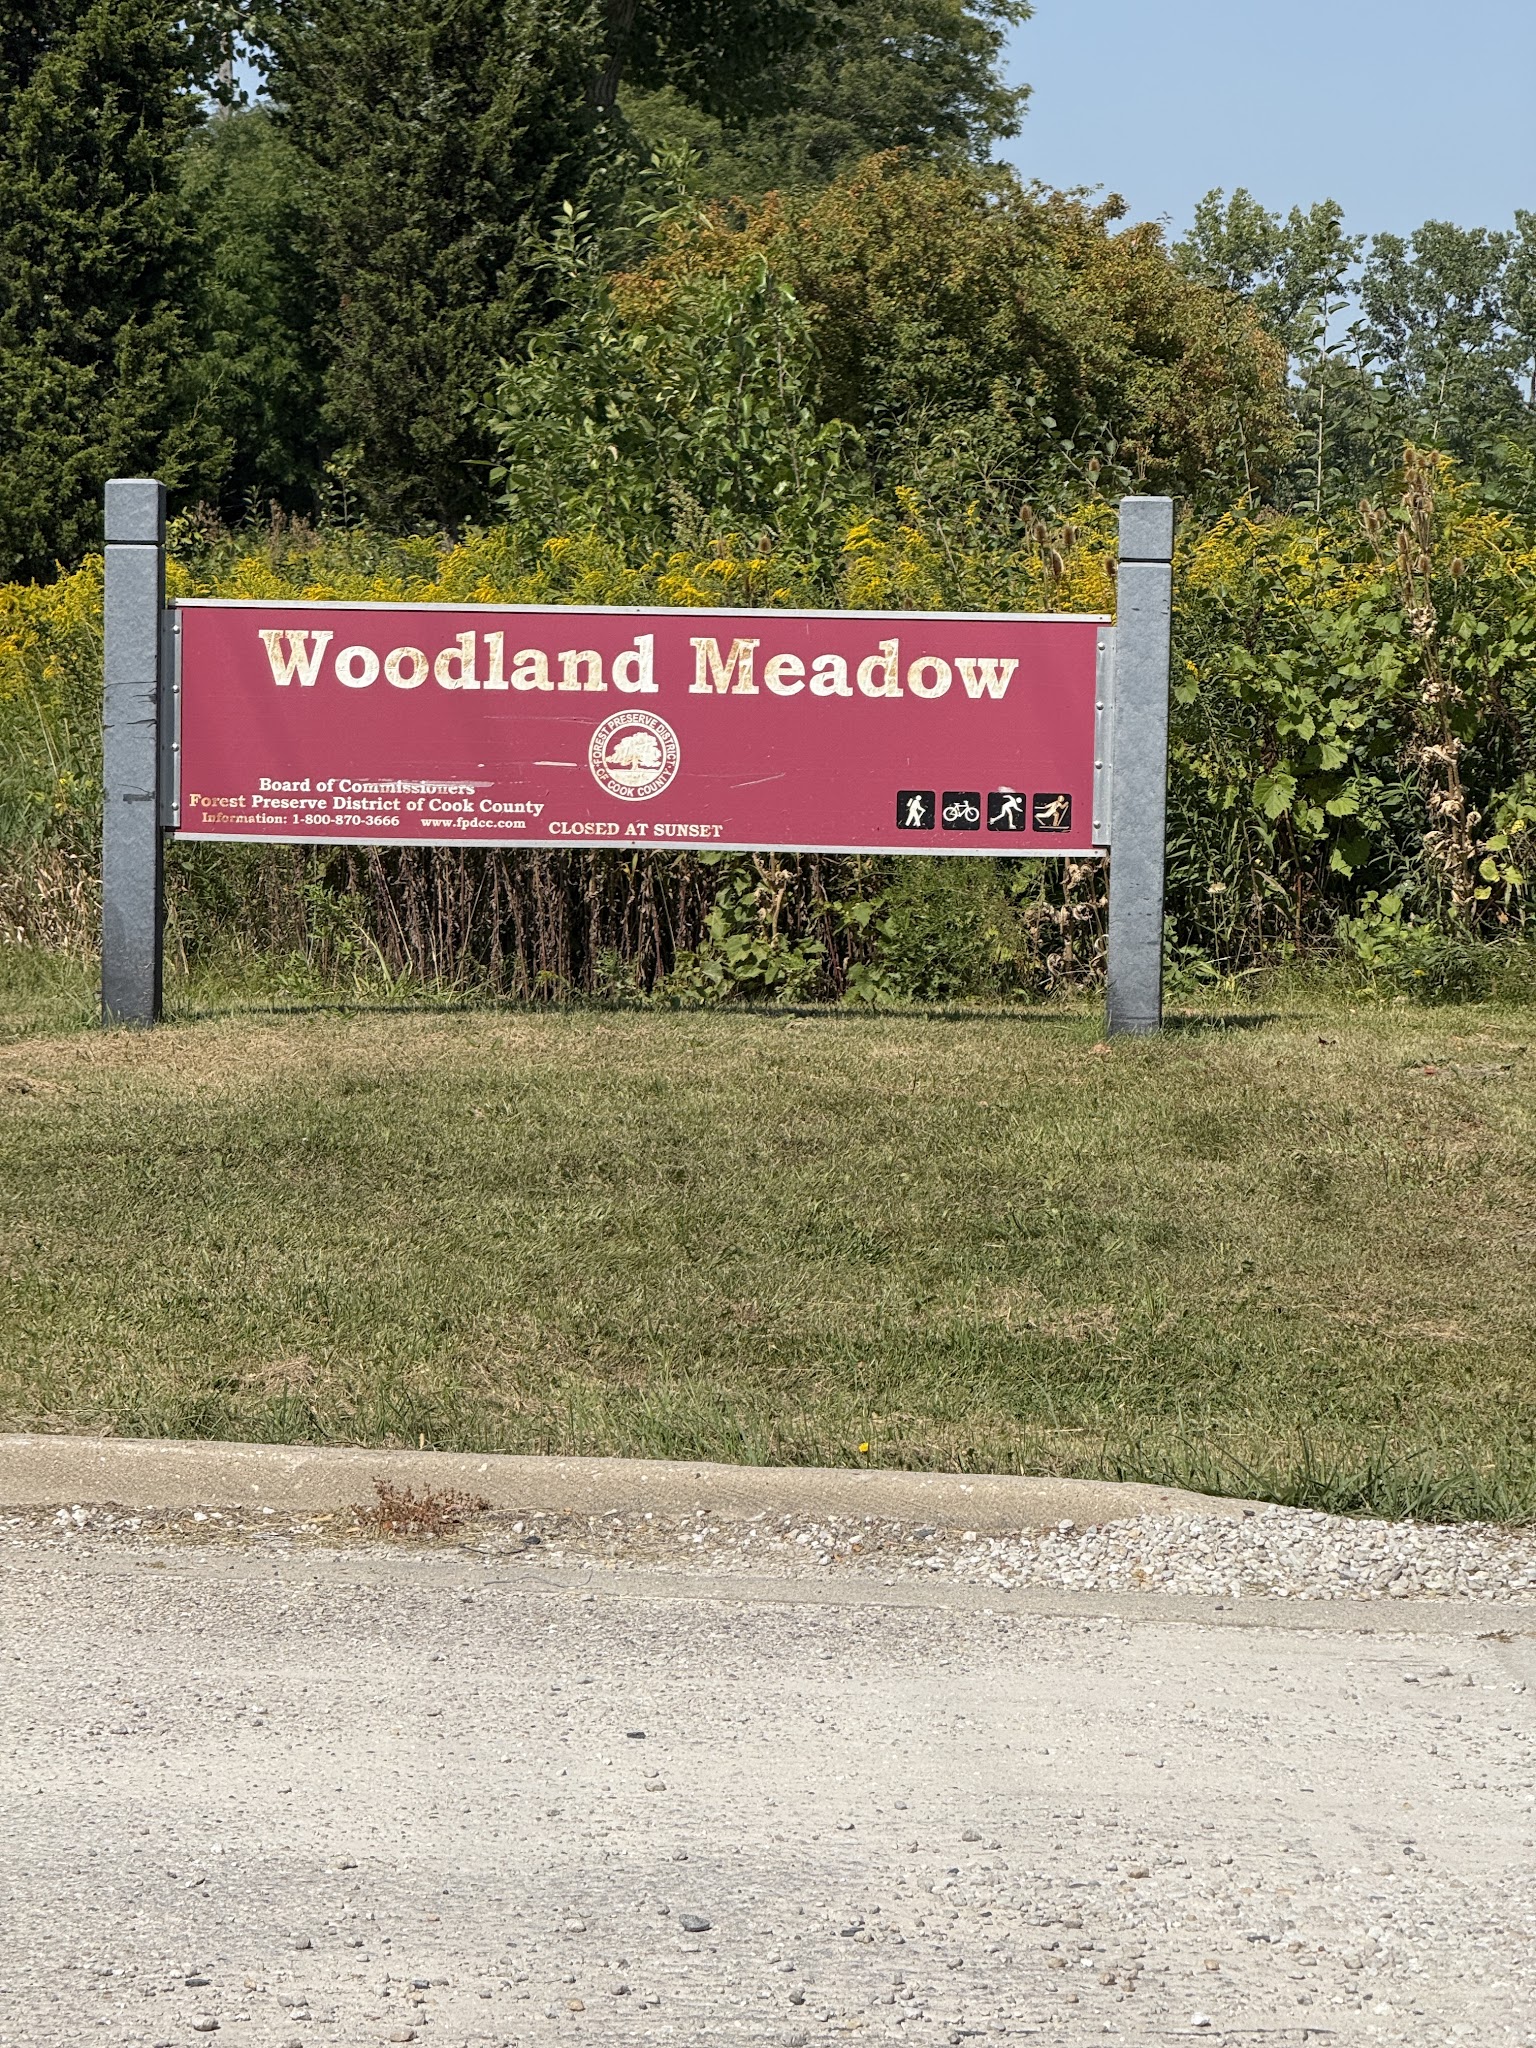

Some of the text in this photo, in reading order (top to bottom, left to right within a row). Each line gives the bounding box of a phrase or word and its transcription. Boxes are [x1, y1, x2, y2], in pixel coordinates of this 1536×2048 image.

[258, 629, 1019, 699] Woodland Meadow
[593, 713, 676, 766] FOREST PRESERVE DISTRICT
[259, 777, 475, 795] Board of Commissioners
[596, 768, 672, 797] OF COOK COUNTY
[189, 793, 545, 817] Forest Preserve District of Cook County
[202, 811, 526, 831] Information: 1-800-870-3666 www.fpdcc.com
[548, 821, 723, 838] CLOSED AT SUNSET
